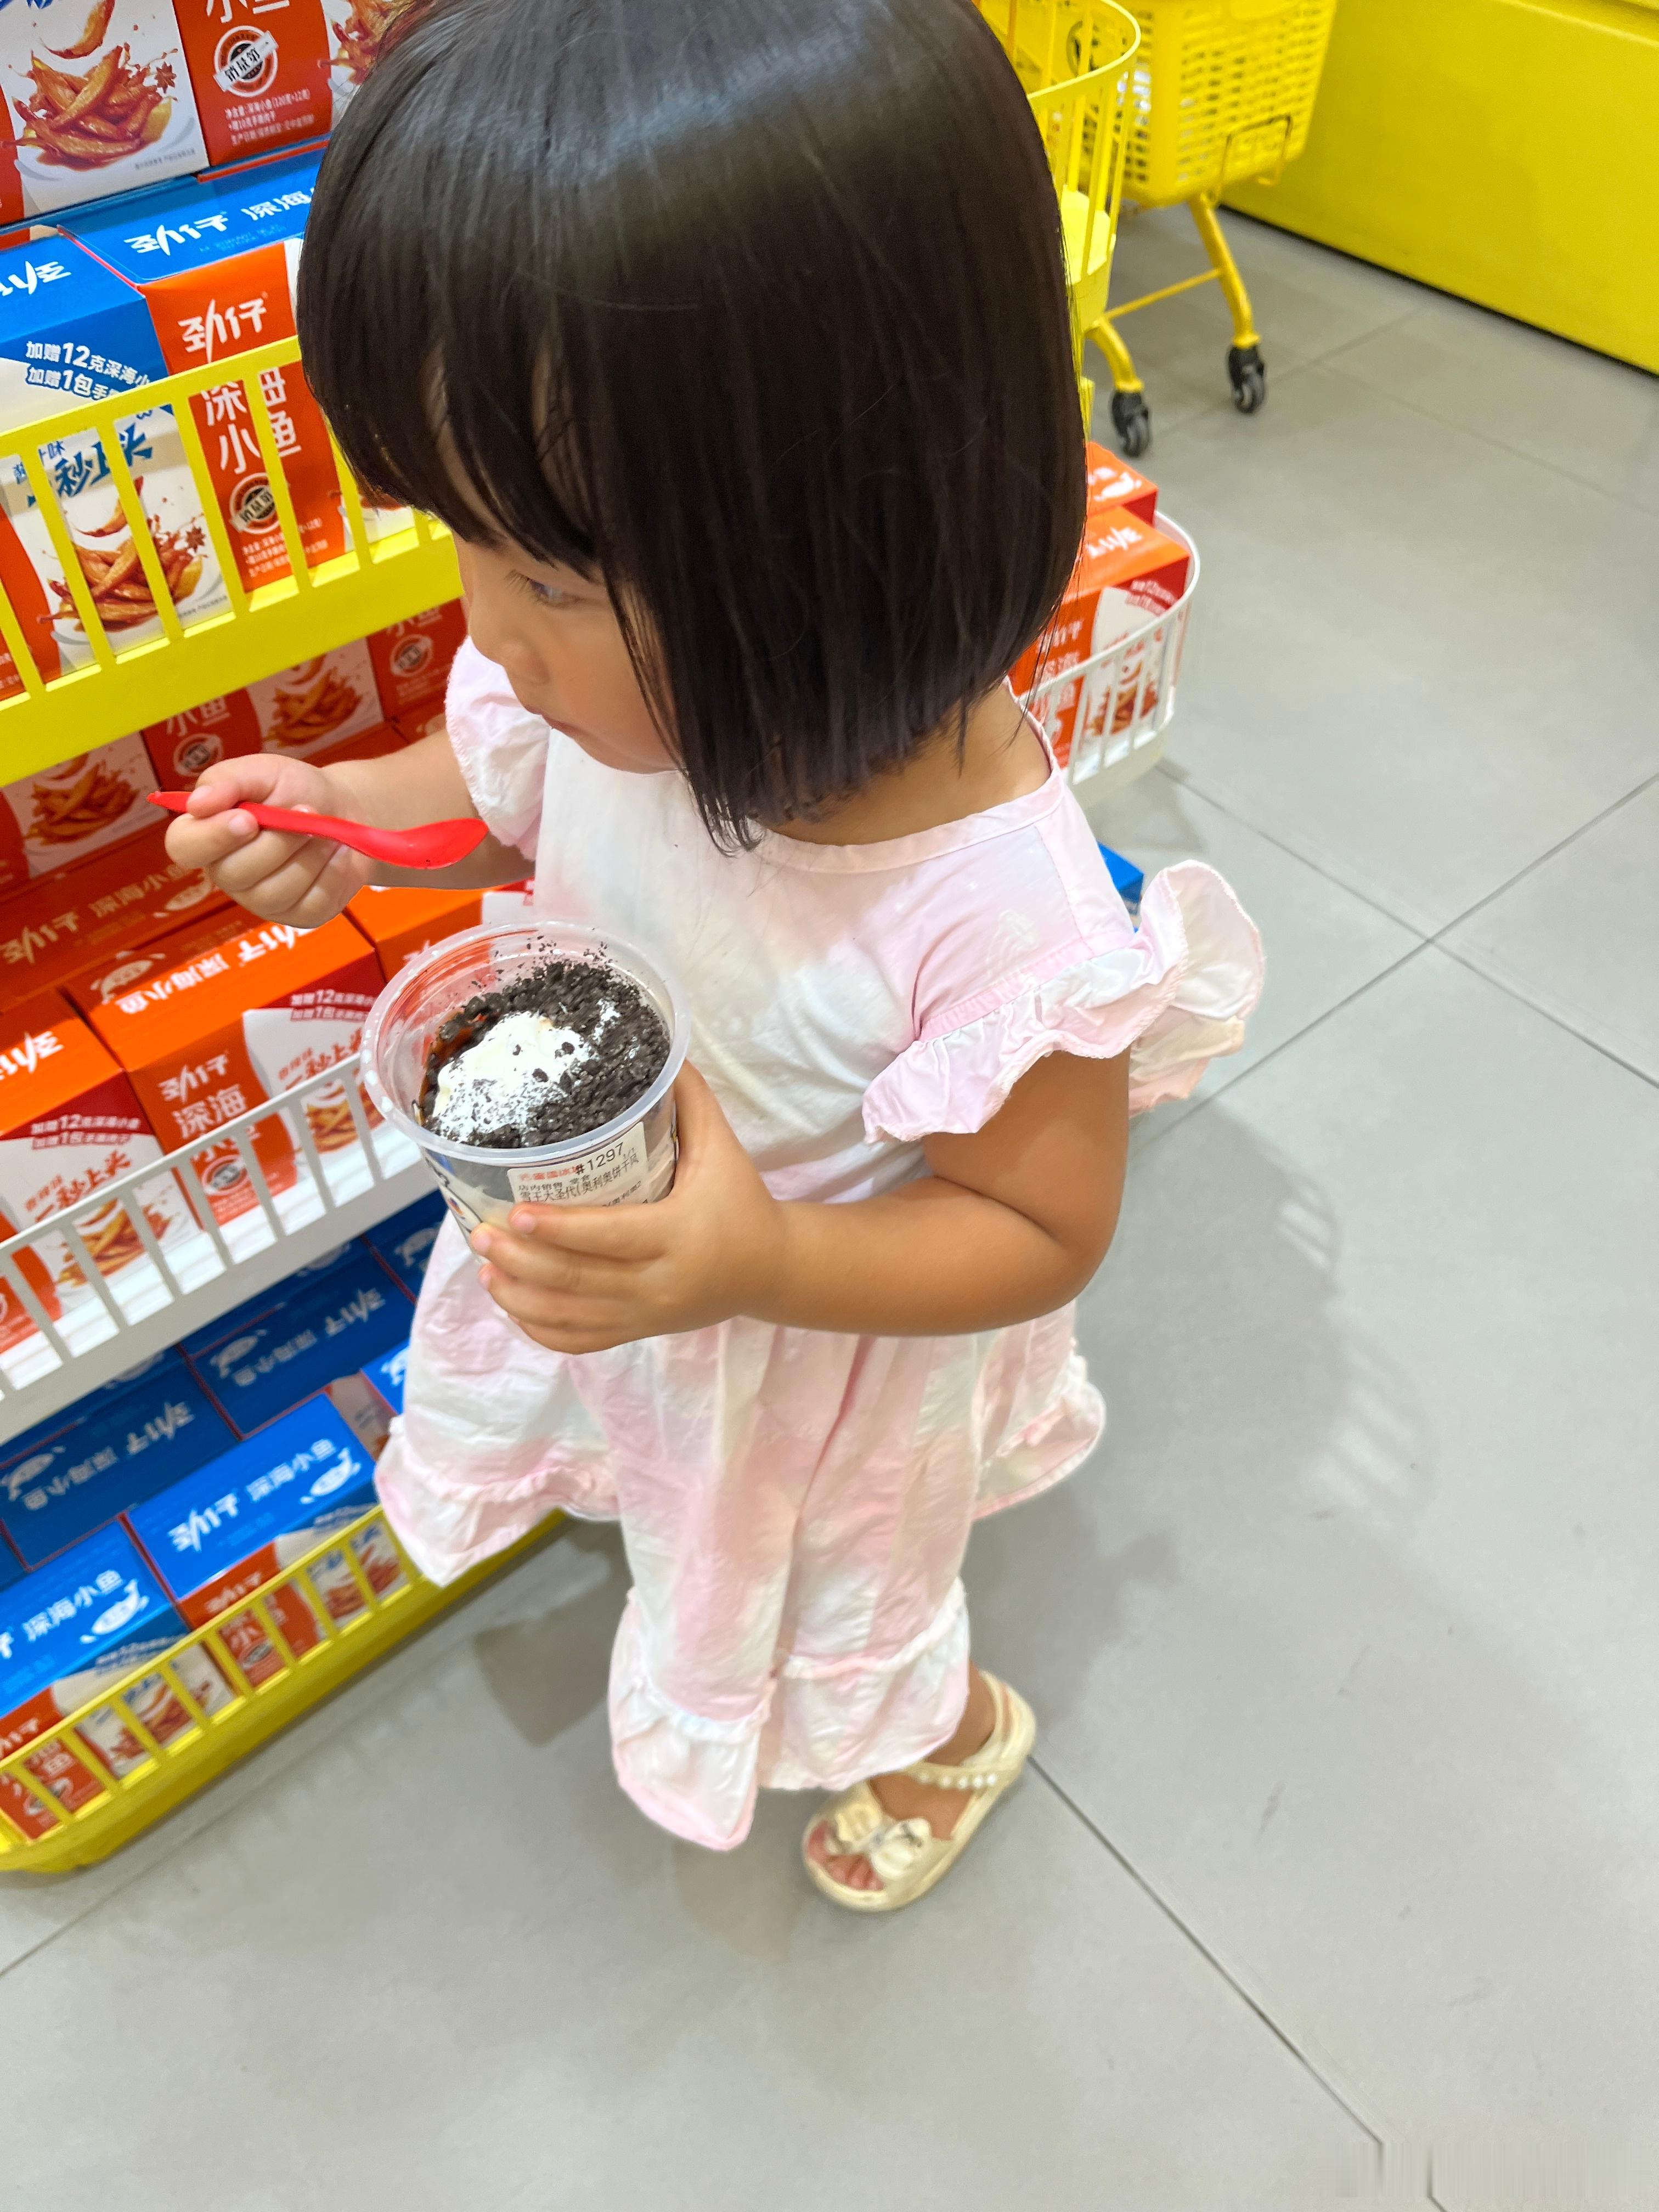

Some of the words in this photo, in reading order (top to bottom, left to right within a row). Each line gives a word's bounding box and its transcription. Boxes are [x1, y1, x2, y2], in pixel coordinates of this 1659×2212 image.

[123, 214, 228, 256] 劲仔
[240, 188, 314, 221] 深海
[177, 298, 267, 363] 劲仔
[575, 1142, 624, 1175] #1297
